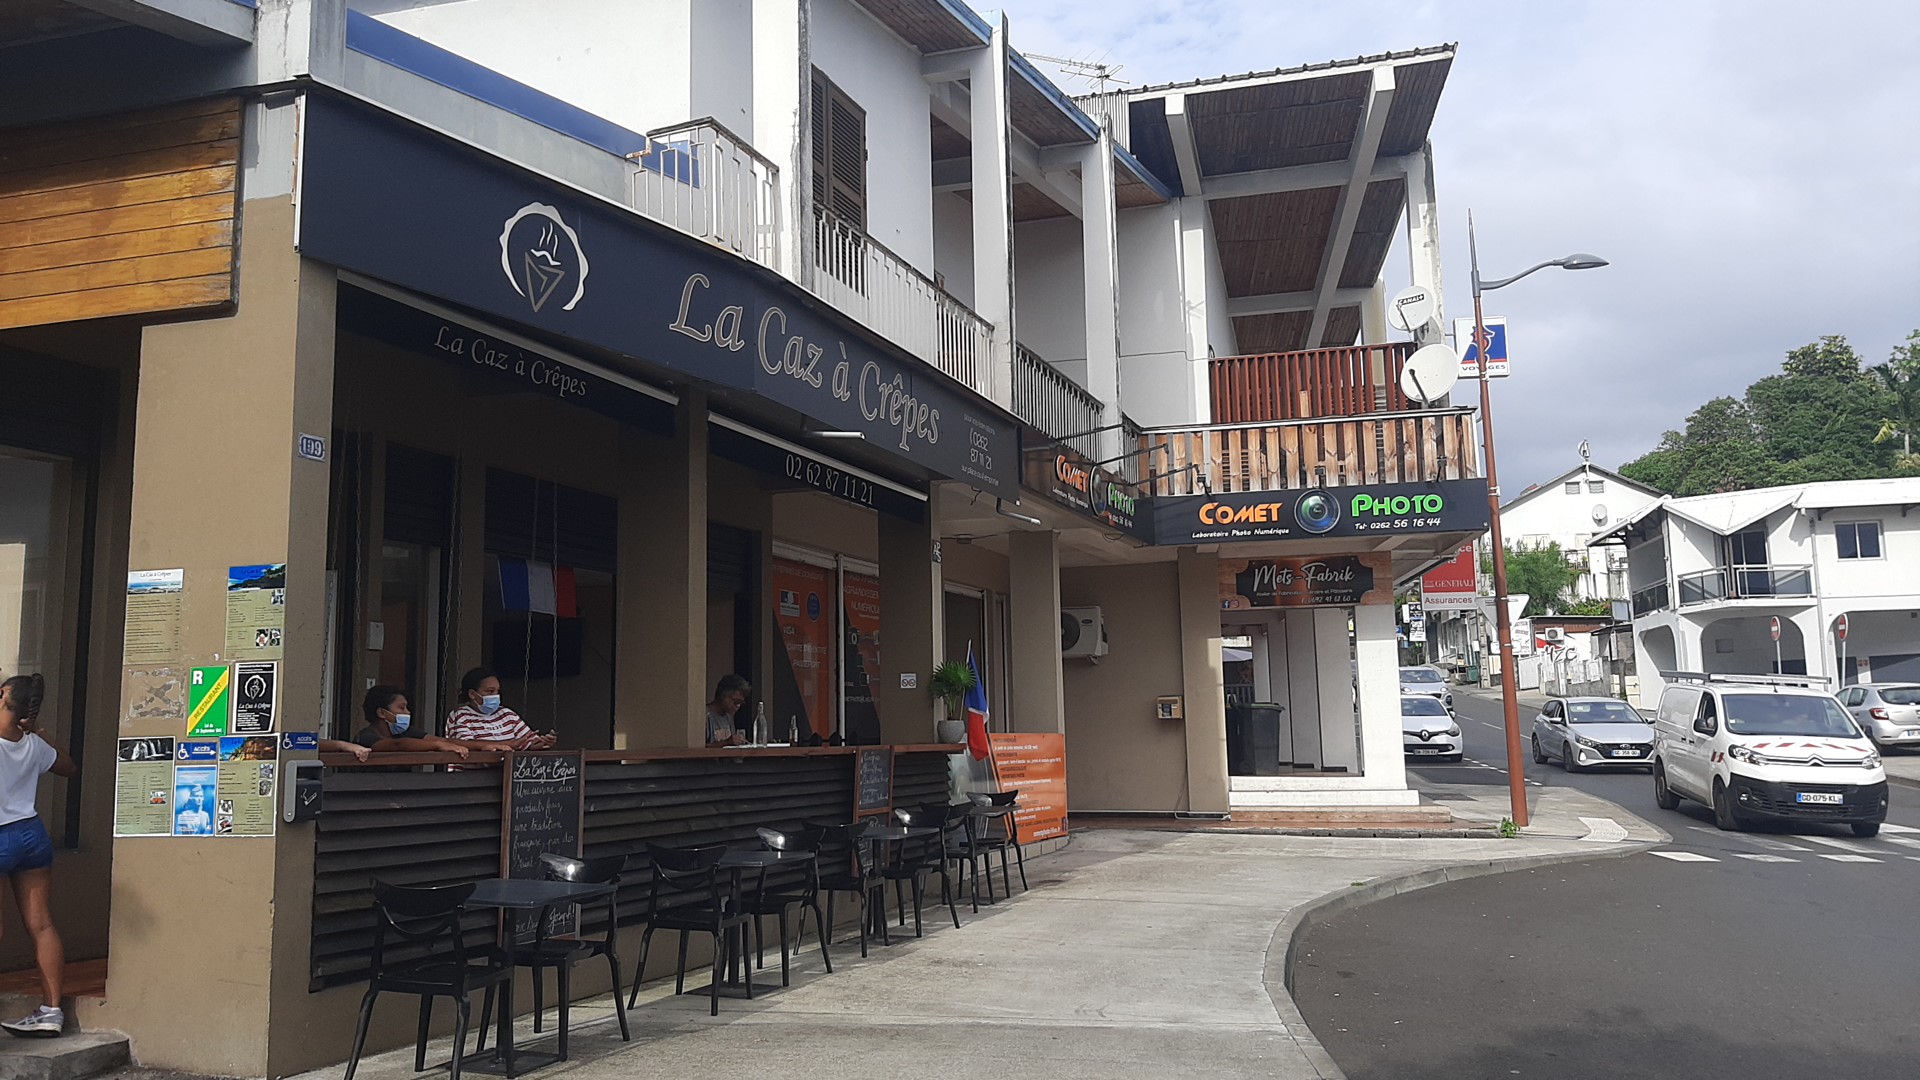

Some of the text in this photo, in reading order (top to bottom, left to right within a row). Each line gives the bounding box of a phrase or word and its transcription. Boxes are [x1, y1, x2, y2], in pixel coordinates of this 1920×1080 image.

[1397, 294, 1424, 305] CANAL+
[434, 326, 587, 398] La Caz à Crêpes
[668, 273, 941, 452] La Caz à Crêpes
[970, 448, 979, 463] 87
[785, 454, 873, 506] 02 62 87 11 21
[1055, 454, 1088, 493] COMET
[1107, 482, 1136, 517] PHOTO
[1351, 493, 1443, 517] PHOTO
[1199, 502, 1283, 525] COMET
[1370, 522, 1391, 530] 0262
[1393, 519, 1409, 528] 56
[1412, 518, 1425, 527] 16
[1426, 517, 1441, 527] 44
[1192, 527, 1290, 539] Laboratoire Photo Numérique
[1434, 579, 1474, 588] GENERALI
[192, 670, 204, 685] R
[193, 681, 223, 720] RESTAURANT
[513, 756, 531, 779] La
